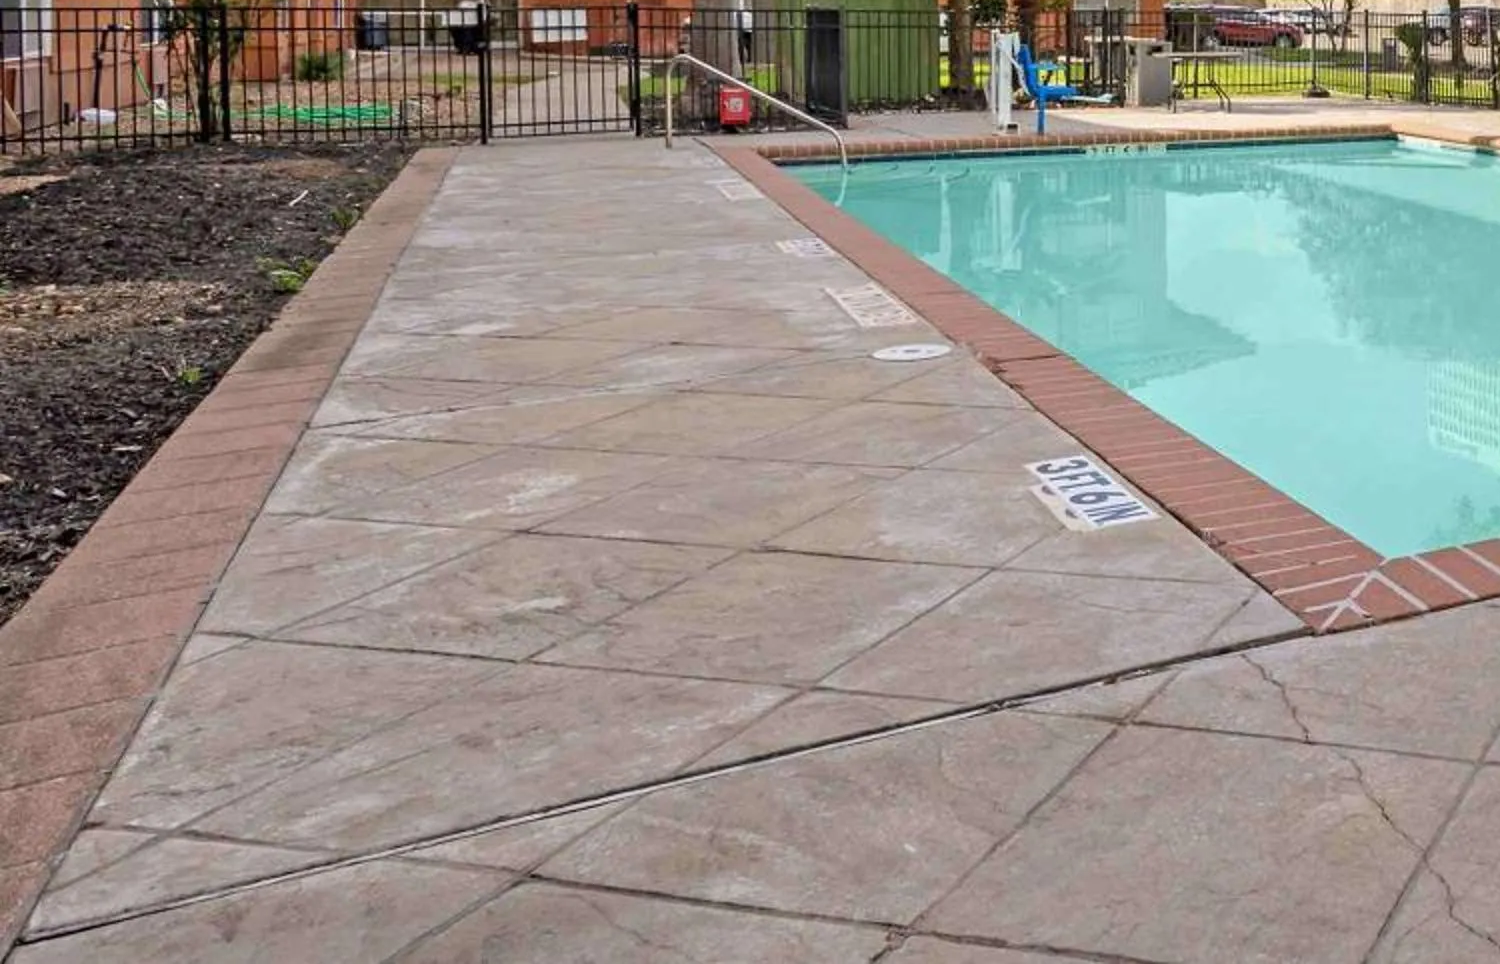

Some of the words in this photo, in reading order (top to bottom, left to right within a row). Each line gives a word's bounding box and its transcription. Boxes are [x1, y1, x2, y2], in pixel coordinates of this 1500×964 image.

[1036, 459, 1089, 474] 3
[1069, 491, 1126, 505] 6
[1083, 501, 1149, 523] IN
